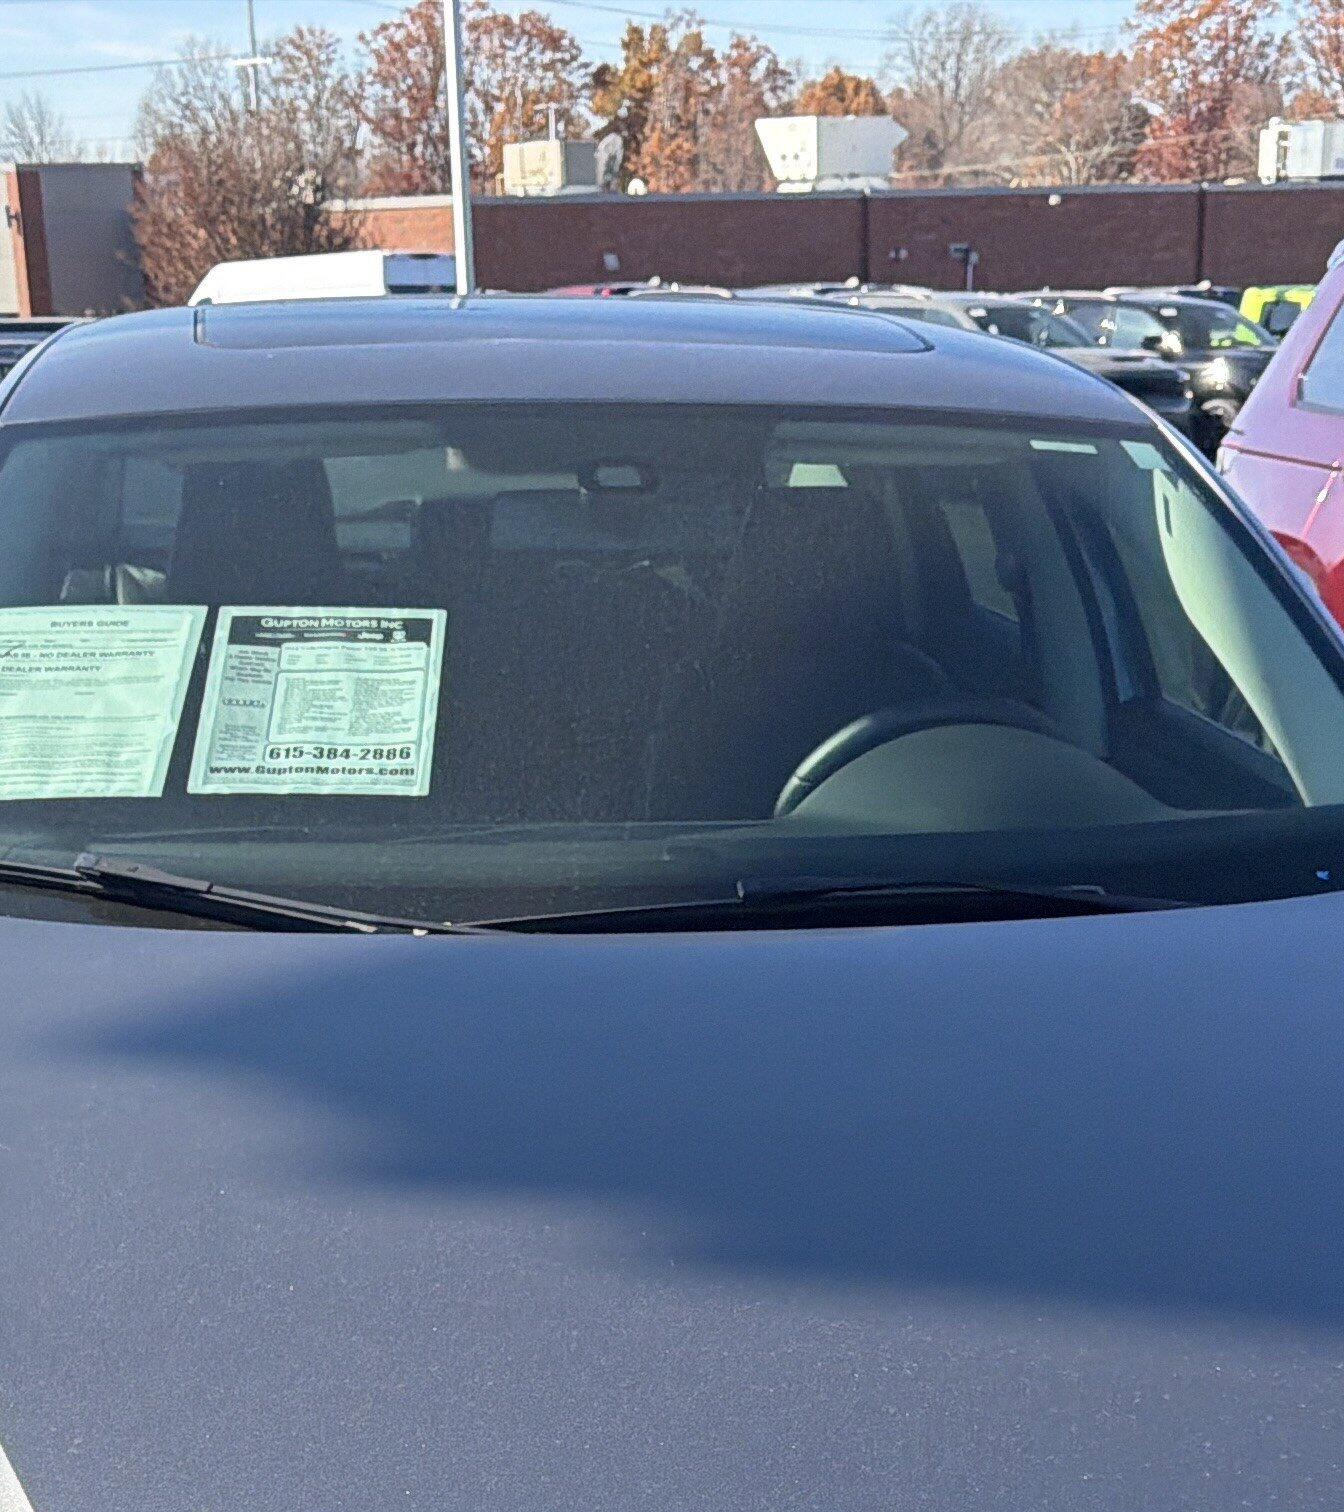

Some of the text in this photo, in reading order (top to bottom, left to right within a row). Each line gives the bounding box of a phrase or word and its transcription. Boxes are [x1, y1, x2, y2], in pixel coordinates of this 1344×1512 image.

[50, 620, 130, 628] BUYERS GUIDE
[380, 620, 404, 629] INC
[56, 651, 97, 659] DEALER
[99, 650, 155, 658] WARRANTY
[1, 665, 103, 673] DEALER WARRANTY
[268, 746, 412, 760] 615-384-2886
[209, 765, 416, 775] www.GuptonMotors.com
